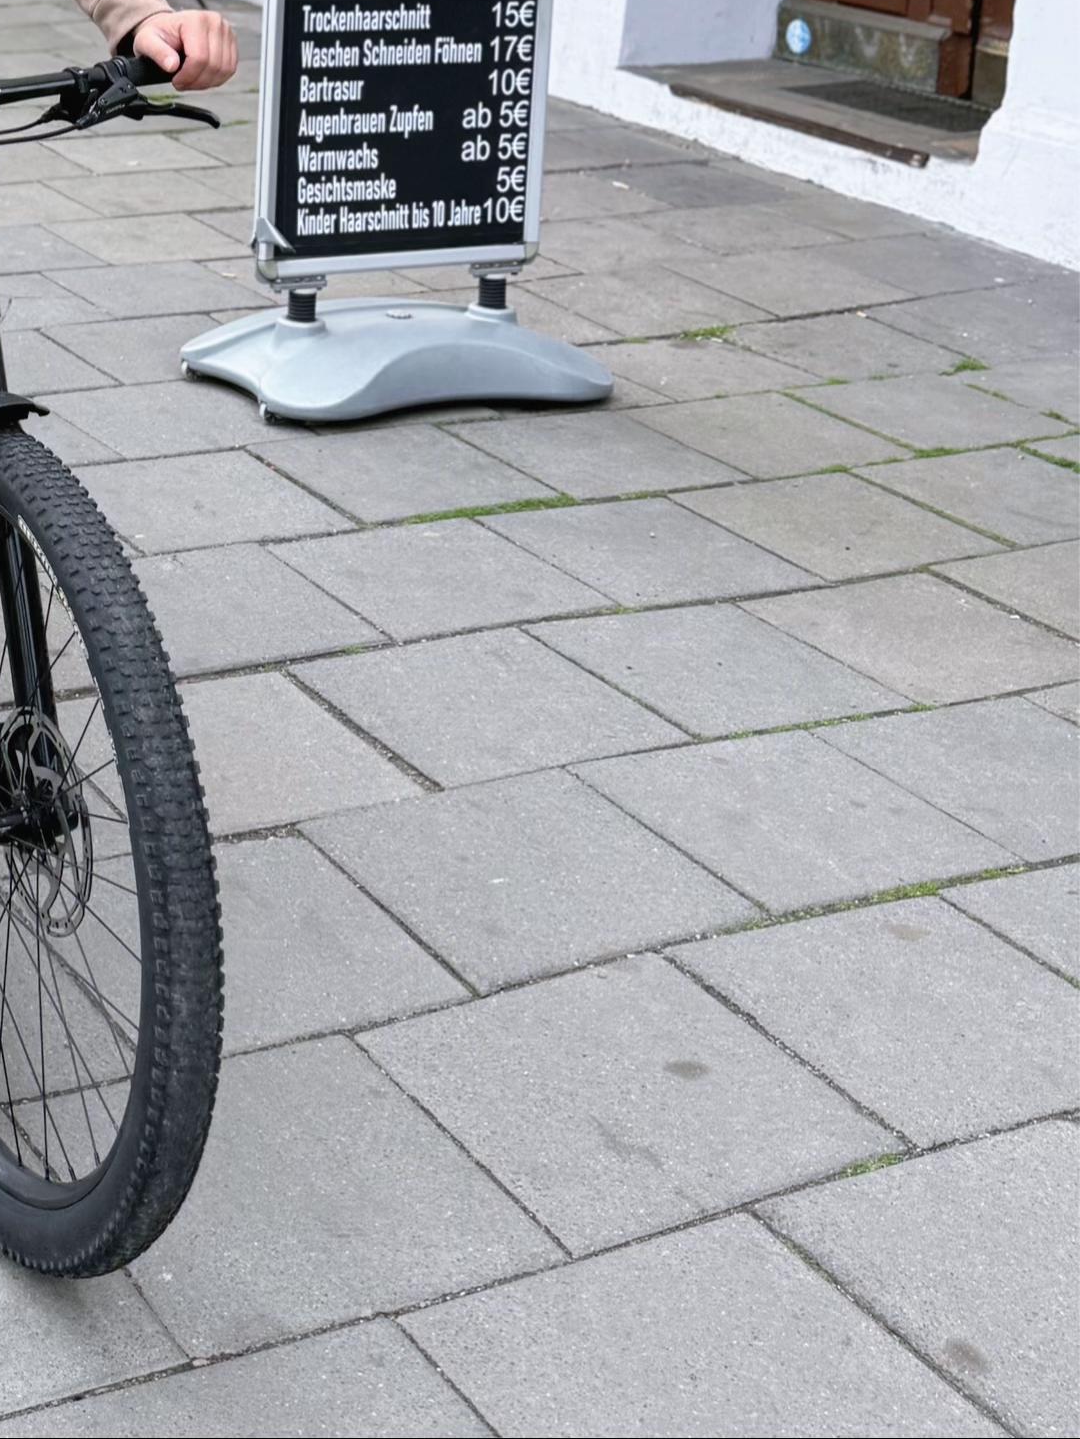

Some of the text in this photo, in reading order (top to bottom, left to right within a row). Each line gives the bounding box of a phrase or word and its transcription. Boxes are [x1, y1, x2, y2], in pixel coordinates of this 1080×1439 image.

[302, 1, 536, 32] Trockenhaarschnitt 15€
[301, 35, 534, 68] Waschen Schneiden Föhnen 17€
[300, 68, 531, 102] Bartrasur 10€
[298, 100, 530, 143] Augenbrauen Zupfen ab 5€
[297, 132, 528, 172] Warmwachs ab 5€
[297, 165, 526, 204] Gesichtsmaske 5€
[297, 196, 525, 236] Kinder Haarschnitt bis 10 Jahre 10€
